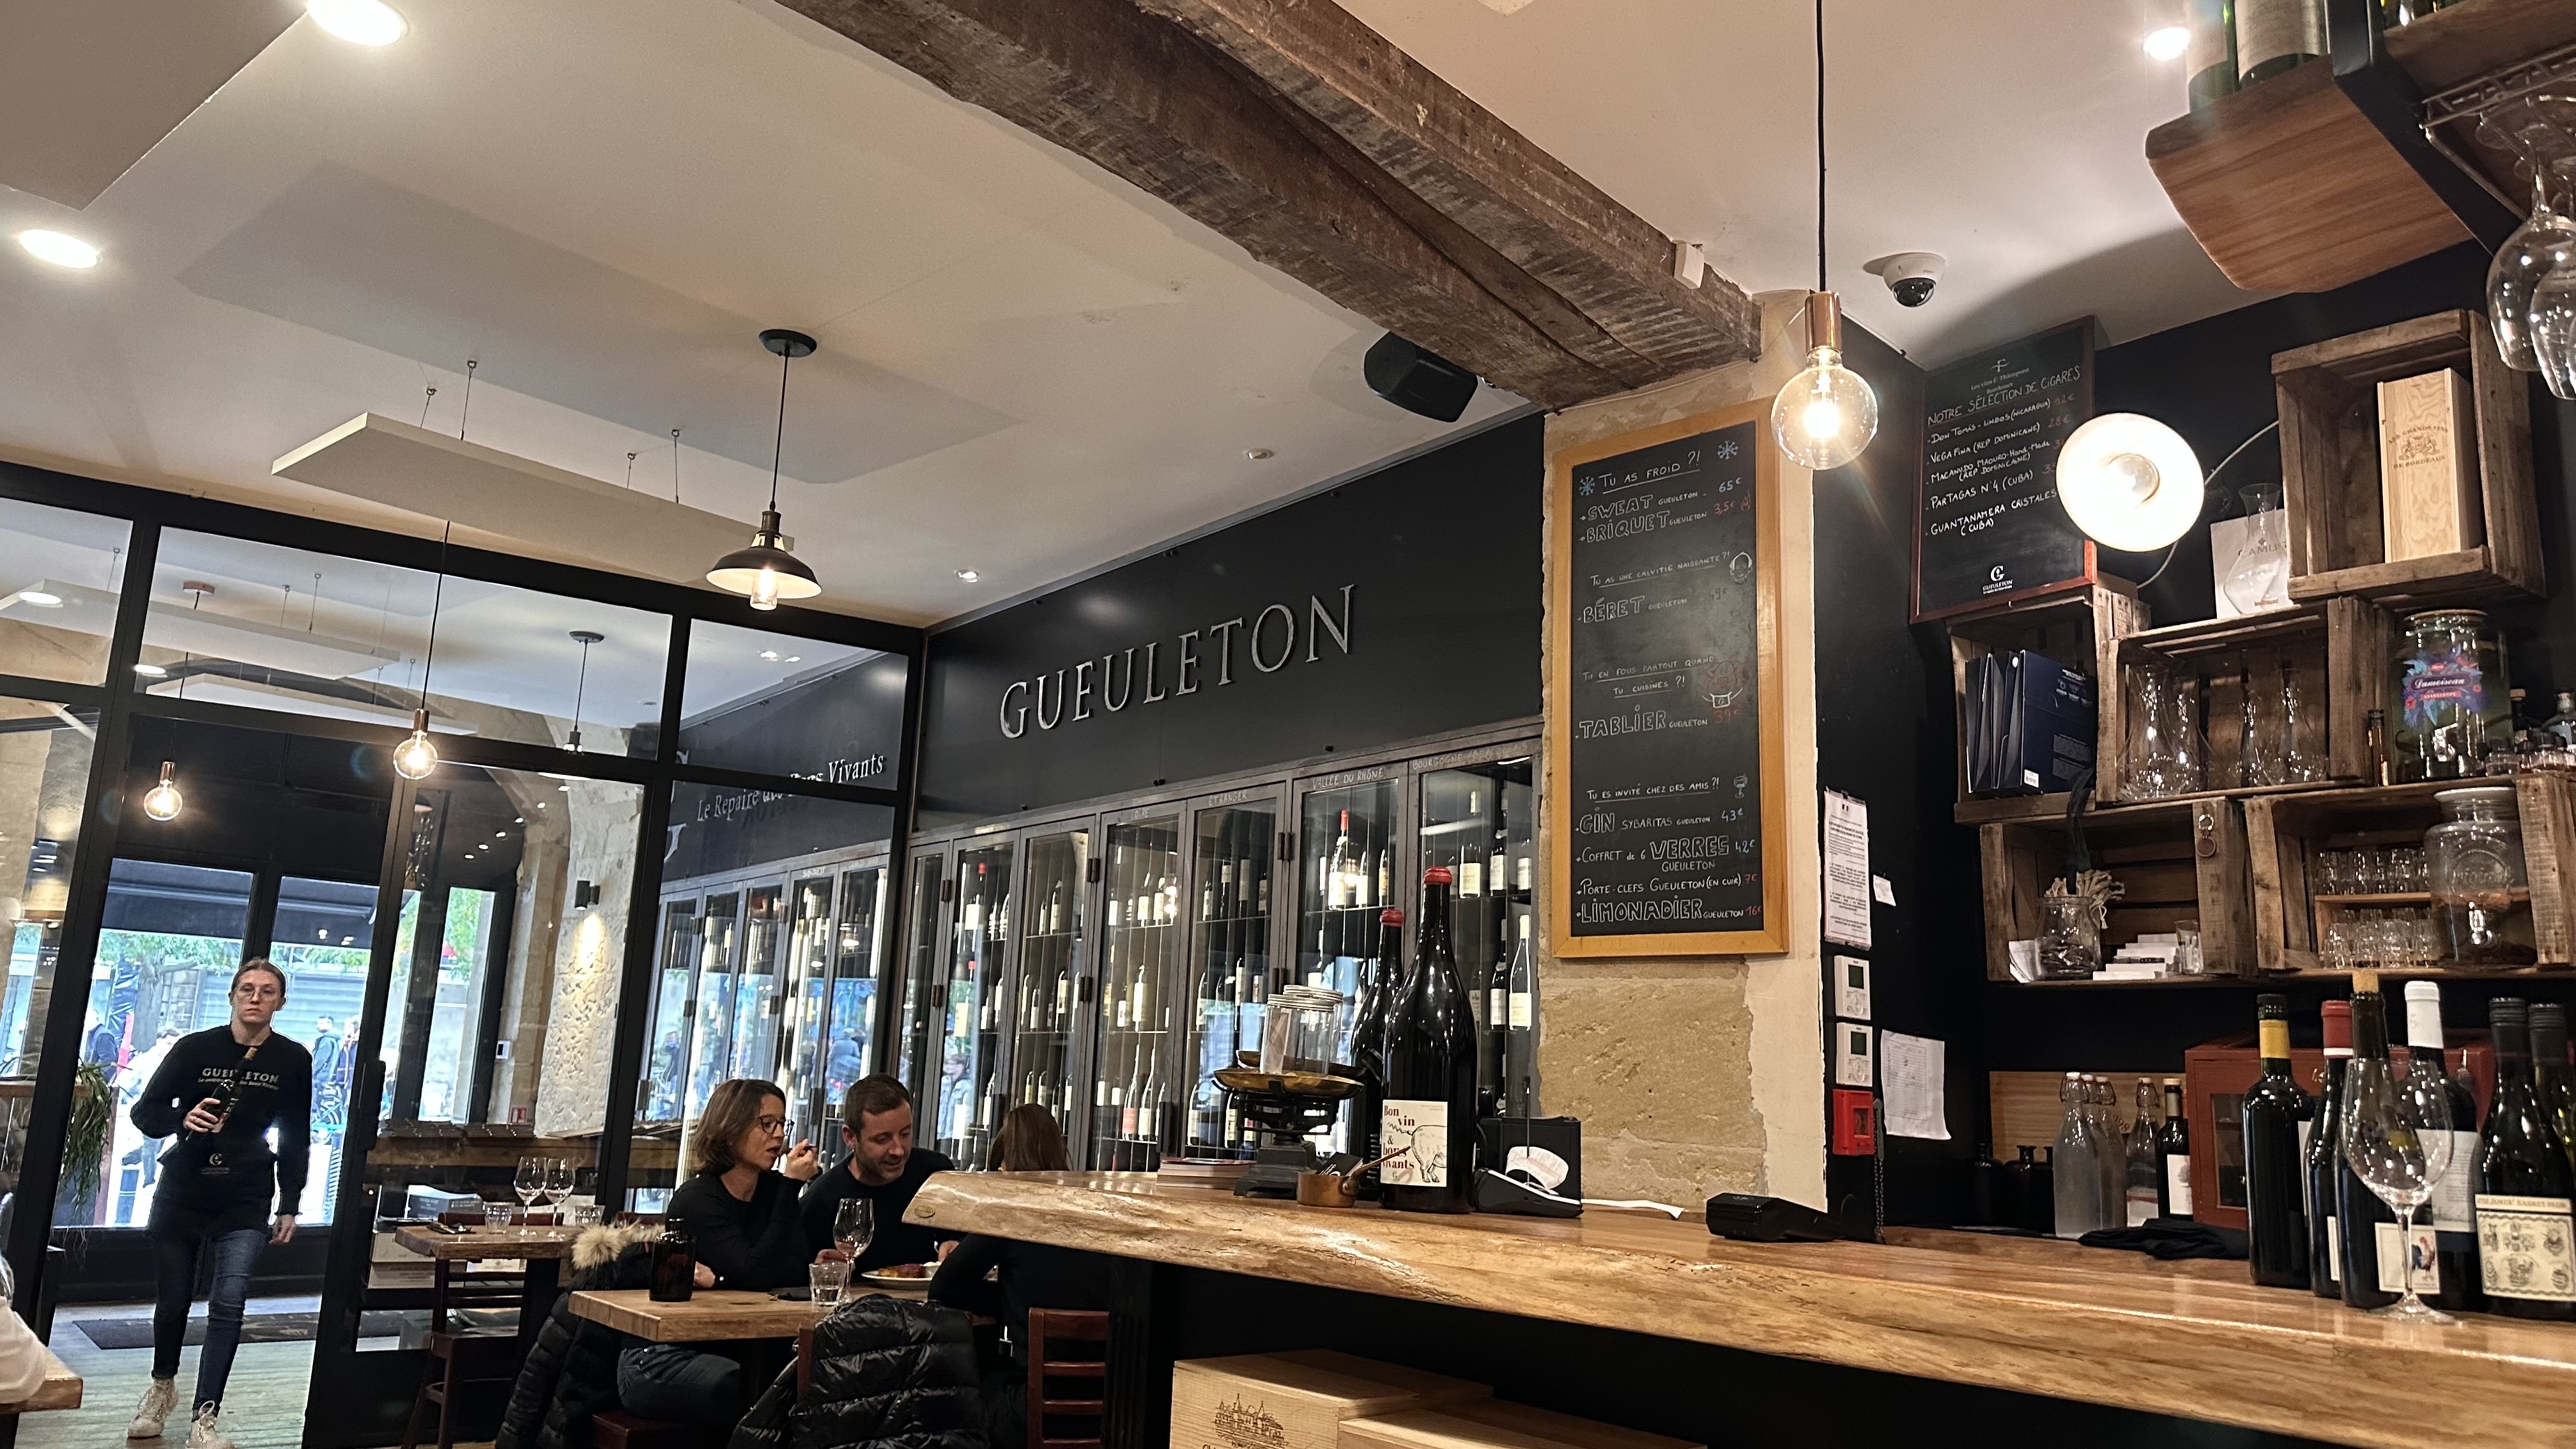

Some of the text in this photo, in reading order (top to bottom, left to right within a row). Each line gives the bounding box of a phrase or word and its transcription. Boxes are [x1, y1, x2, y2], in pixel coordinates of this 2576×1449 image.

[1928, 365, 2080, 426] NOTRE SÉLECTION DE CIGARES
[1624, 473, 1637, 484] AS
[1646, 461, 1680, 479] FROID
[2405, 456, 2446, 467] BORDEAUX
[1930, 487, 1977, 510] PARTAGAS
[2002, 470, 2034, 491] (CUBA)
[1588, 494, 1653, 521] SWEAT
[1658, 492, 1698, 505] GUEULETON
[1931, 488, 2057, 535] GUANTANAMERA CRISTALES
[1586, 510, 1670, 543] BRIQUET
[1669, 512, 1708, 526] GUEULETON
[1604, 576, 1615, 585] AS
[1619, 573, 1633, 581] UNE
[1637, 565, 1674, 577] CALVITIE
[1677, 555, 1721, 569] NAISSANTE
[1583, 595, 1645, 624] BÉRET
[1648, 598, 1687, 611] GUEULETON
[999, 583, 1355, 739] GUEULETON
[1598, 670, 1609, 679] EN
[1616, 667, 1637, 677] FOUS
[1642, 661, 1678, 673] PARTOUT
[1684, 656, 1715, 667] QUAND
[1632, 680, 1669, 693] CUISINES
[1579, 705, 1666, 739] TABLIER
[1669, 719, 1708, 729] GUEULETON
[1413, 753, 1464, 769] BOURGOGNE
[697, 753, 885, 822] Le Repaire Vivants
[1312, 767, 1384, 790] VALLÉE DU RHÔNE
[1615, 783, 1641, 797] INVITÉ
[1646, 786, 1666, 795] CHEZ
[1669, 783, 1685, 793] DES
[1689, 780, 1709, 791] AMIS
[1131, 808, 1149, 820] LOIRE
[1579, 807, 1615, 834] GIN
[1621, 817, 1673, 830] SYBARITAS
[1676, 816, 1712, 826] GUEULETON
[1582, 847, 1623, 863] COFFRET
[1626, 852, 1636, 861] de
[1640, 849, 1646, 860] 6
[1649, 835, 1729, 860] VERRES
[1661, 859, 1716, 873] GUEULETON
[1650, 877, 1706, 892] GUEULETON
[1721, 872, 1742, 887] CUIR)
[1744, 873, 1758, 885] 7€
[1581, 895, 1703, 923] LIMONADIER
[1703, 909, 1744, 919] GUEULETON
[202, 1068, 279, 1084] GUEETON
[1384, 1105, 1399, 1116] Bon
[1398, 1115, 1415, 1126] vin
[1387, 1135, 1394, 1145] &
